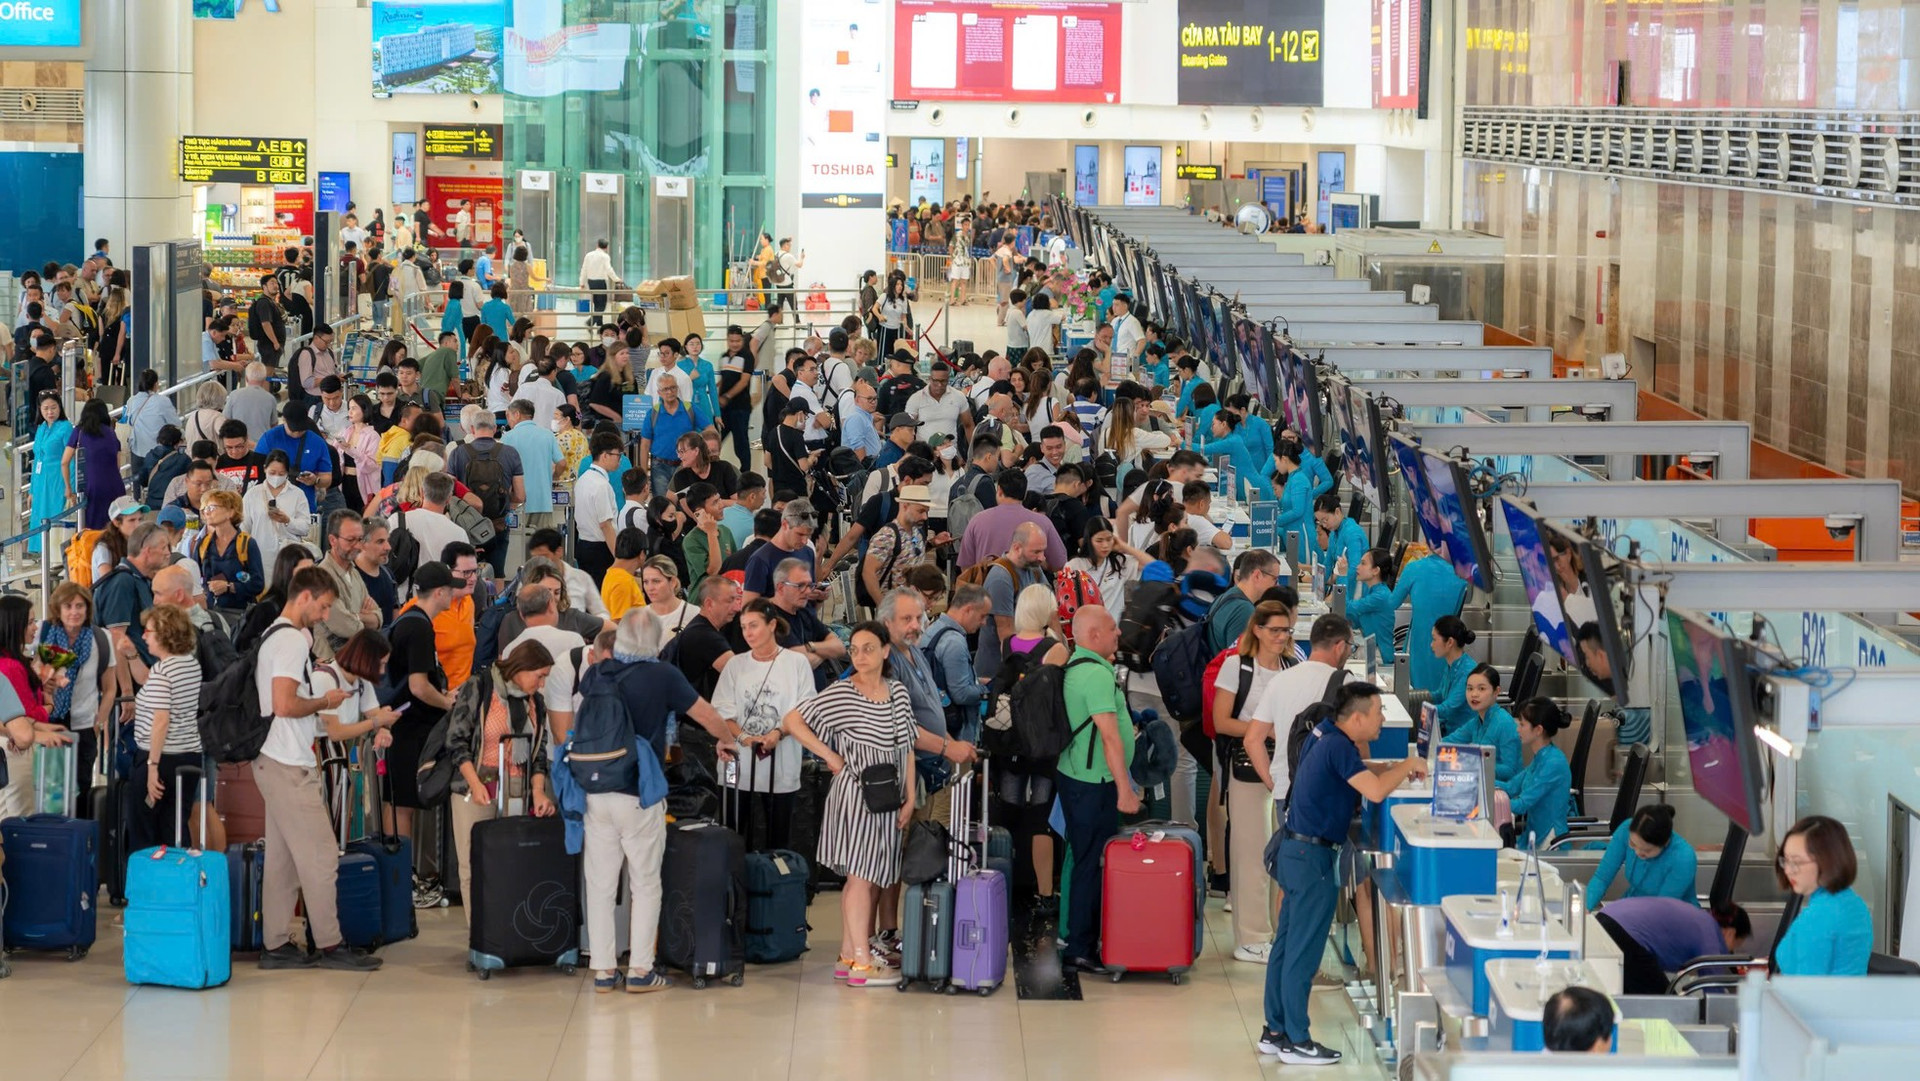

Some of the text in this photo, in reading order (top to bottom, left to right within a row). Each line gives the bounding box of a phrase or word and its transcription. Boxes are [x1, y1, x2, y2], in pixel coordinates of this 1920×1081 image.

[0, 2, 54, 21] Office
[1182, 21, 1263, 47] CỬA RA TÀU BAY
[1267, 30, 1299, 62] 1-12
[1182, 53, 1228, 69] Boarding Gates
[257, 171, 266, 182] B
[812, 164, 874, 175] TOSHIBA
[1802, 612, 1826, 668] B28
